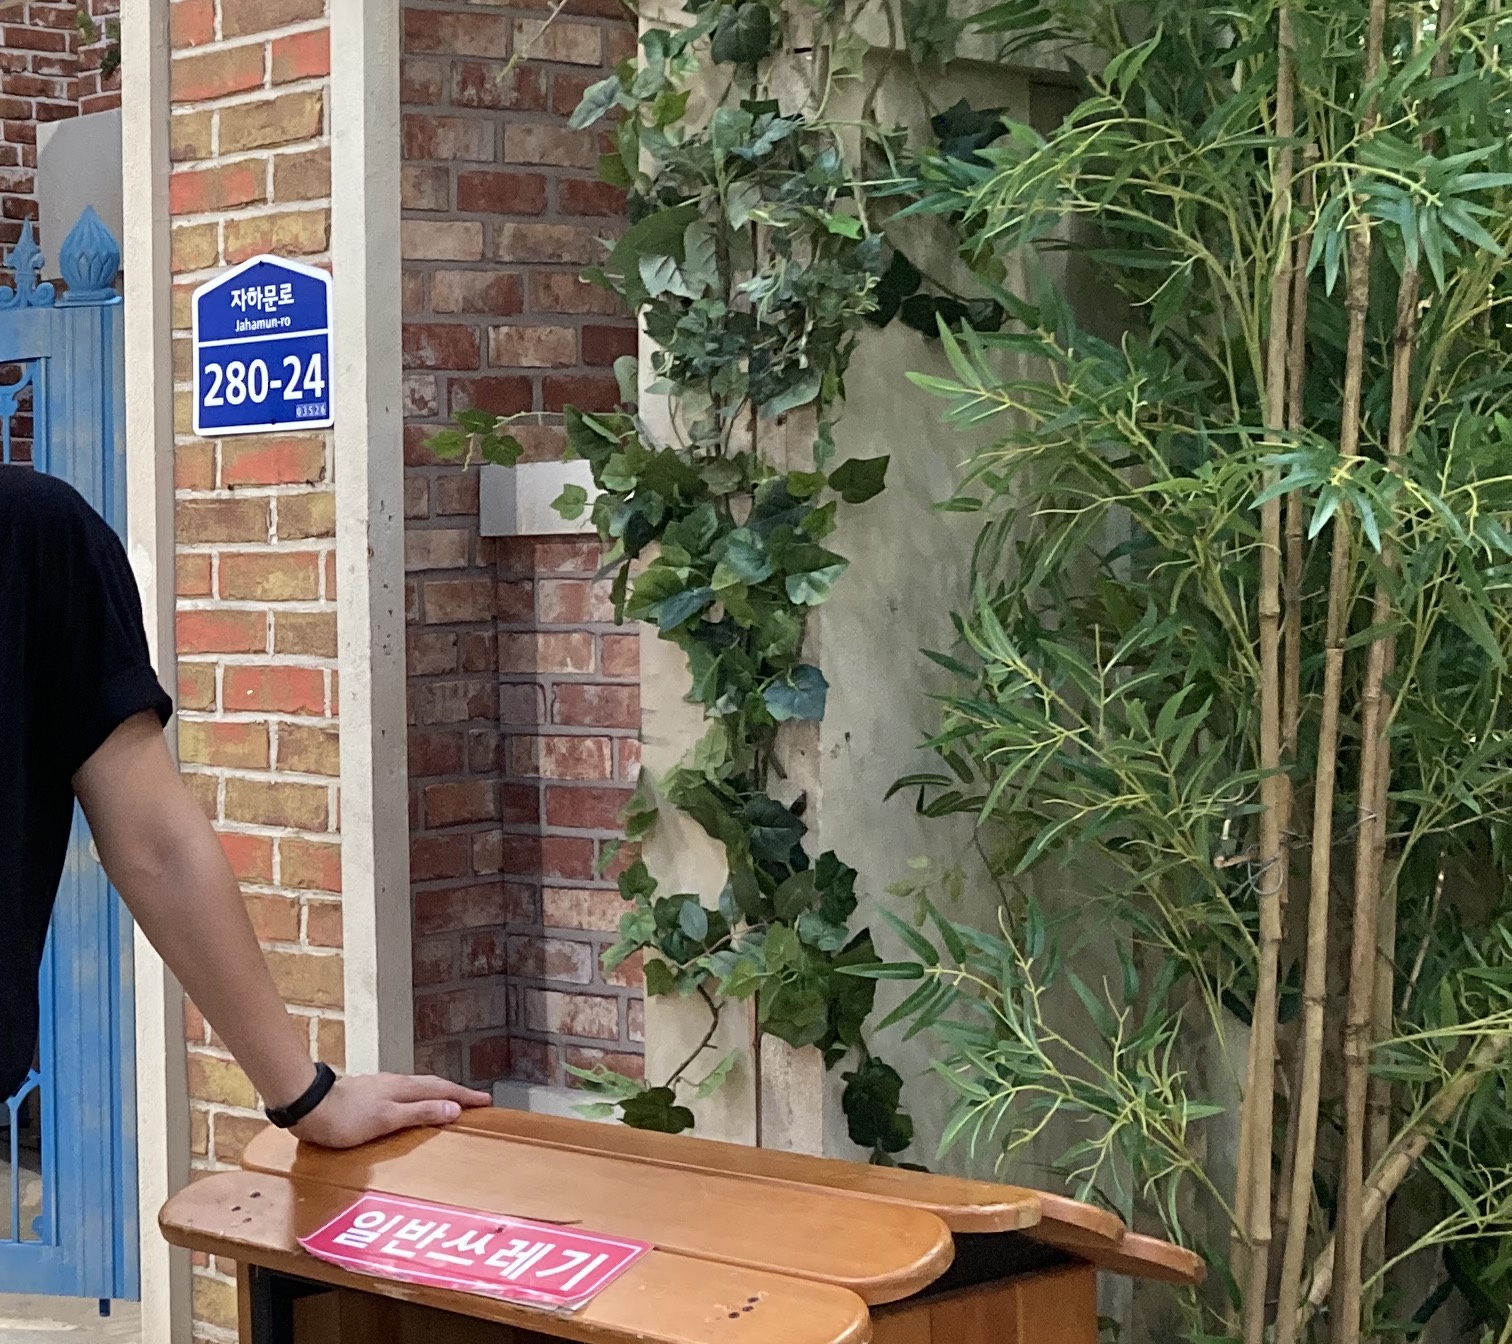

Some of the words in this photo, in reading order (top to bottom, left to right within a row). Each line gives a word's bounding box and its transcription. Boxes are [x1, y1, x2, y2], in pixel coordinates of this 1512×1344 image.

[230, 282, 295, 313] 자하문로
[235, 315, 292, 333] Jahamun-ro
[203, 352, 326, 407] 280-24
[296, 404, 327, 417] 03526
[331, 1209, 609, 1292] 일반쓰레기
